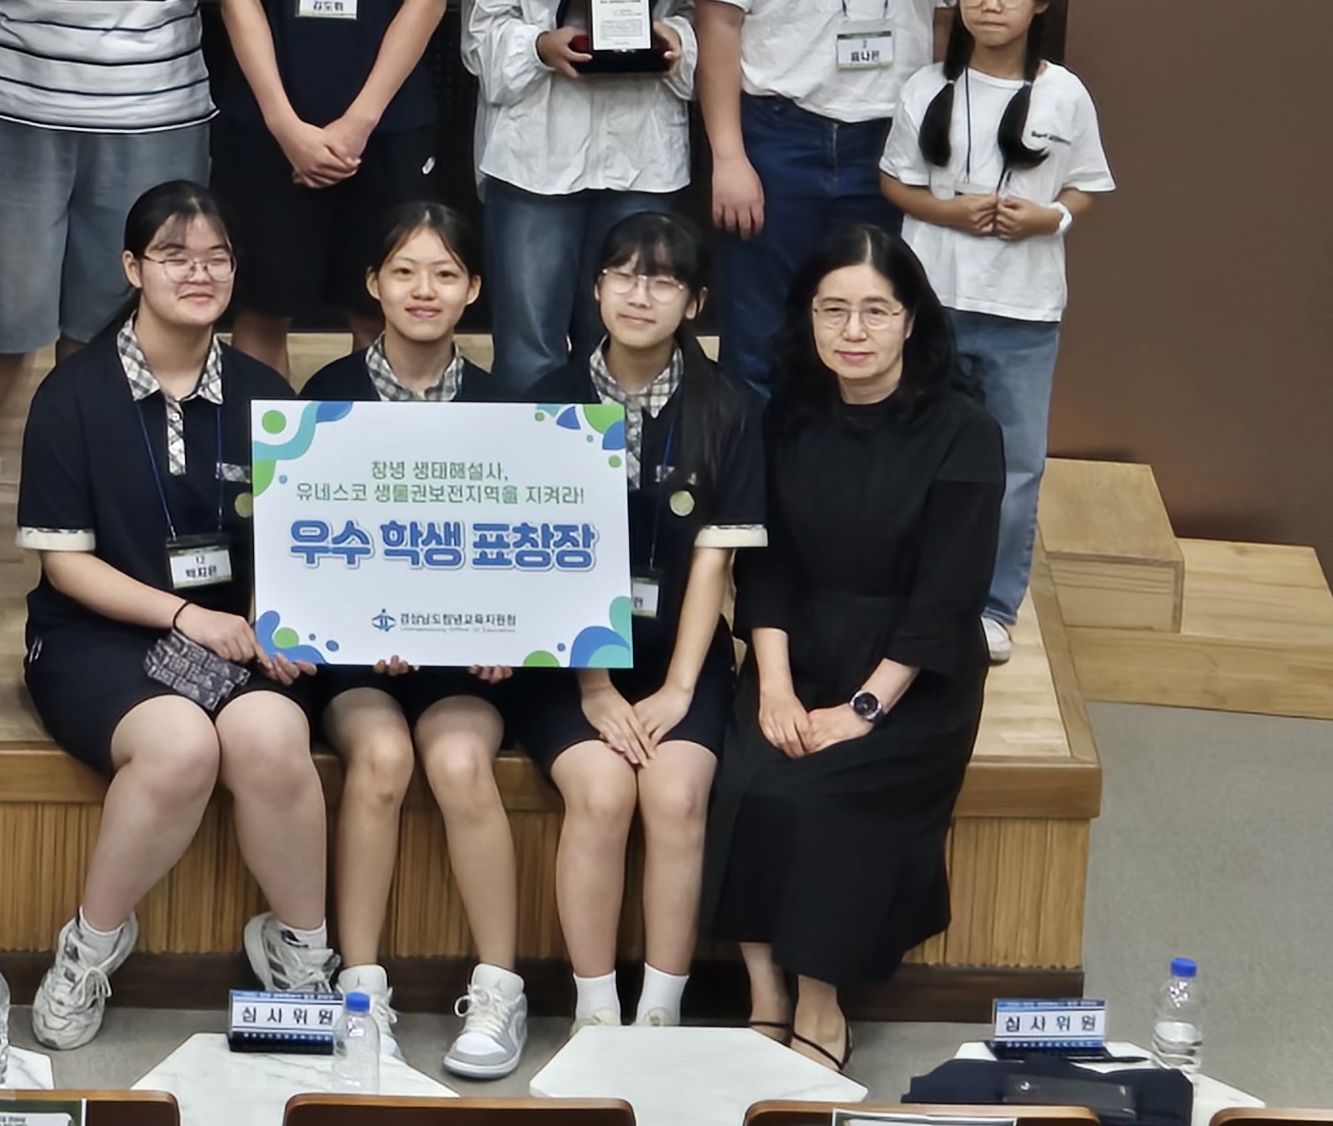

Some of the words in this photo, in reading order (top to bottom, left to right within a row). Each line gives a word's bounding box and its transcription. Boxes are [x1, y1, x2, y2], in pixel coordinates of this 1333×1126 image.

[371, 461, 405, 480] 창녕
[296, 483, 367, 502] 유네스코
[290, 520, 370, 567] 우수
[380, 520, 462, 567] 학생
[472, 523, 596, 568] 표창장
[242, 1006, 333, 1025] 심사위원
[1005, 1015, 1096, 1032] 심사위원
